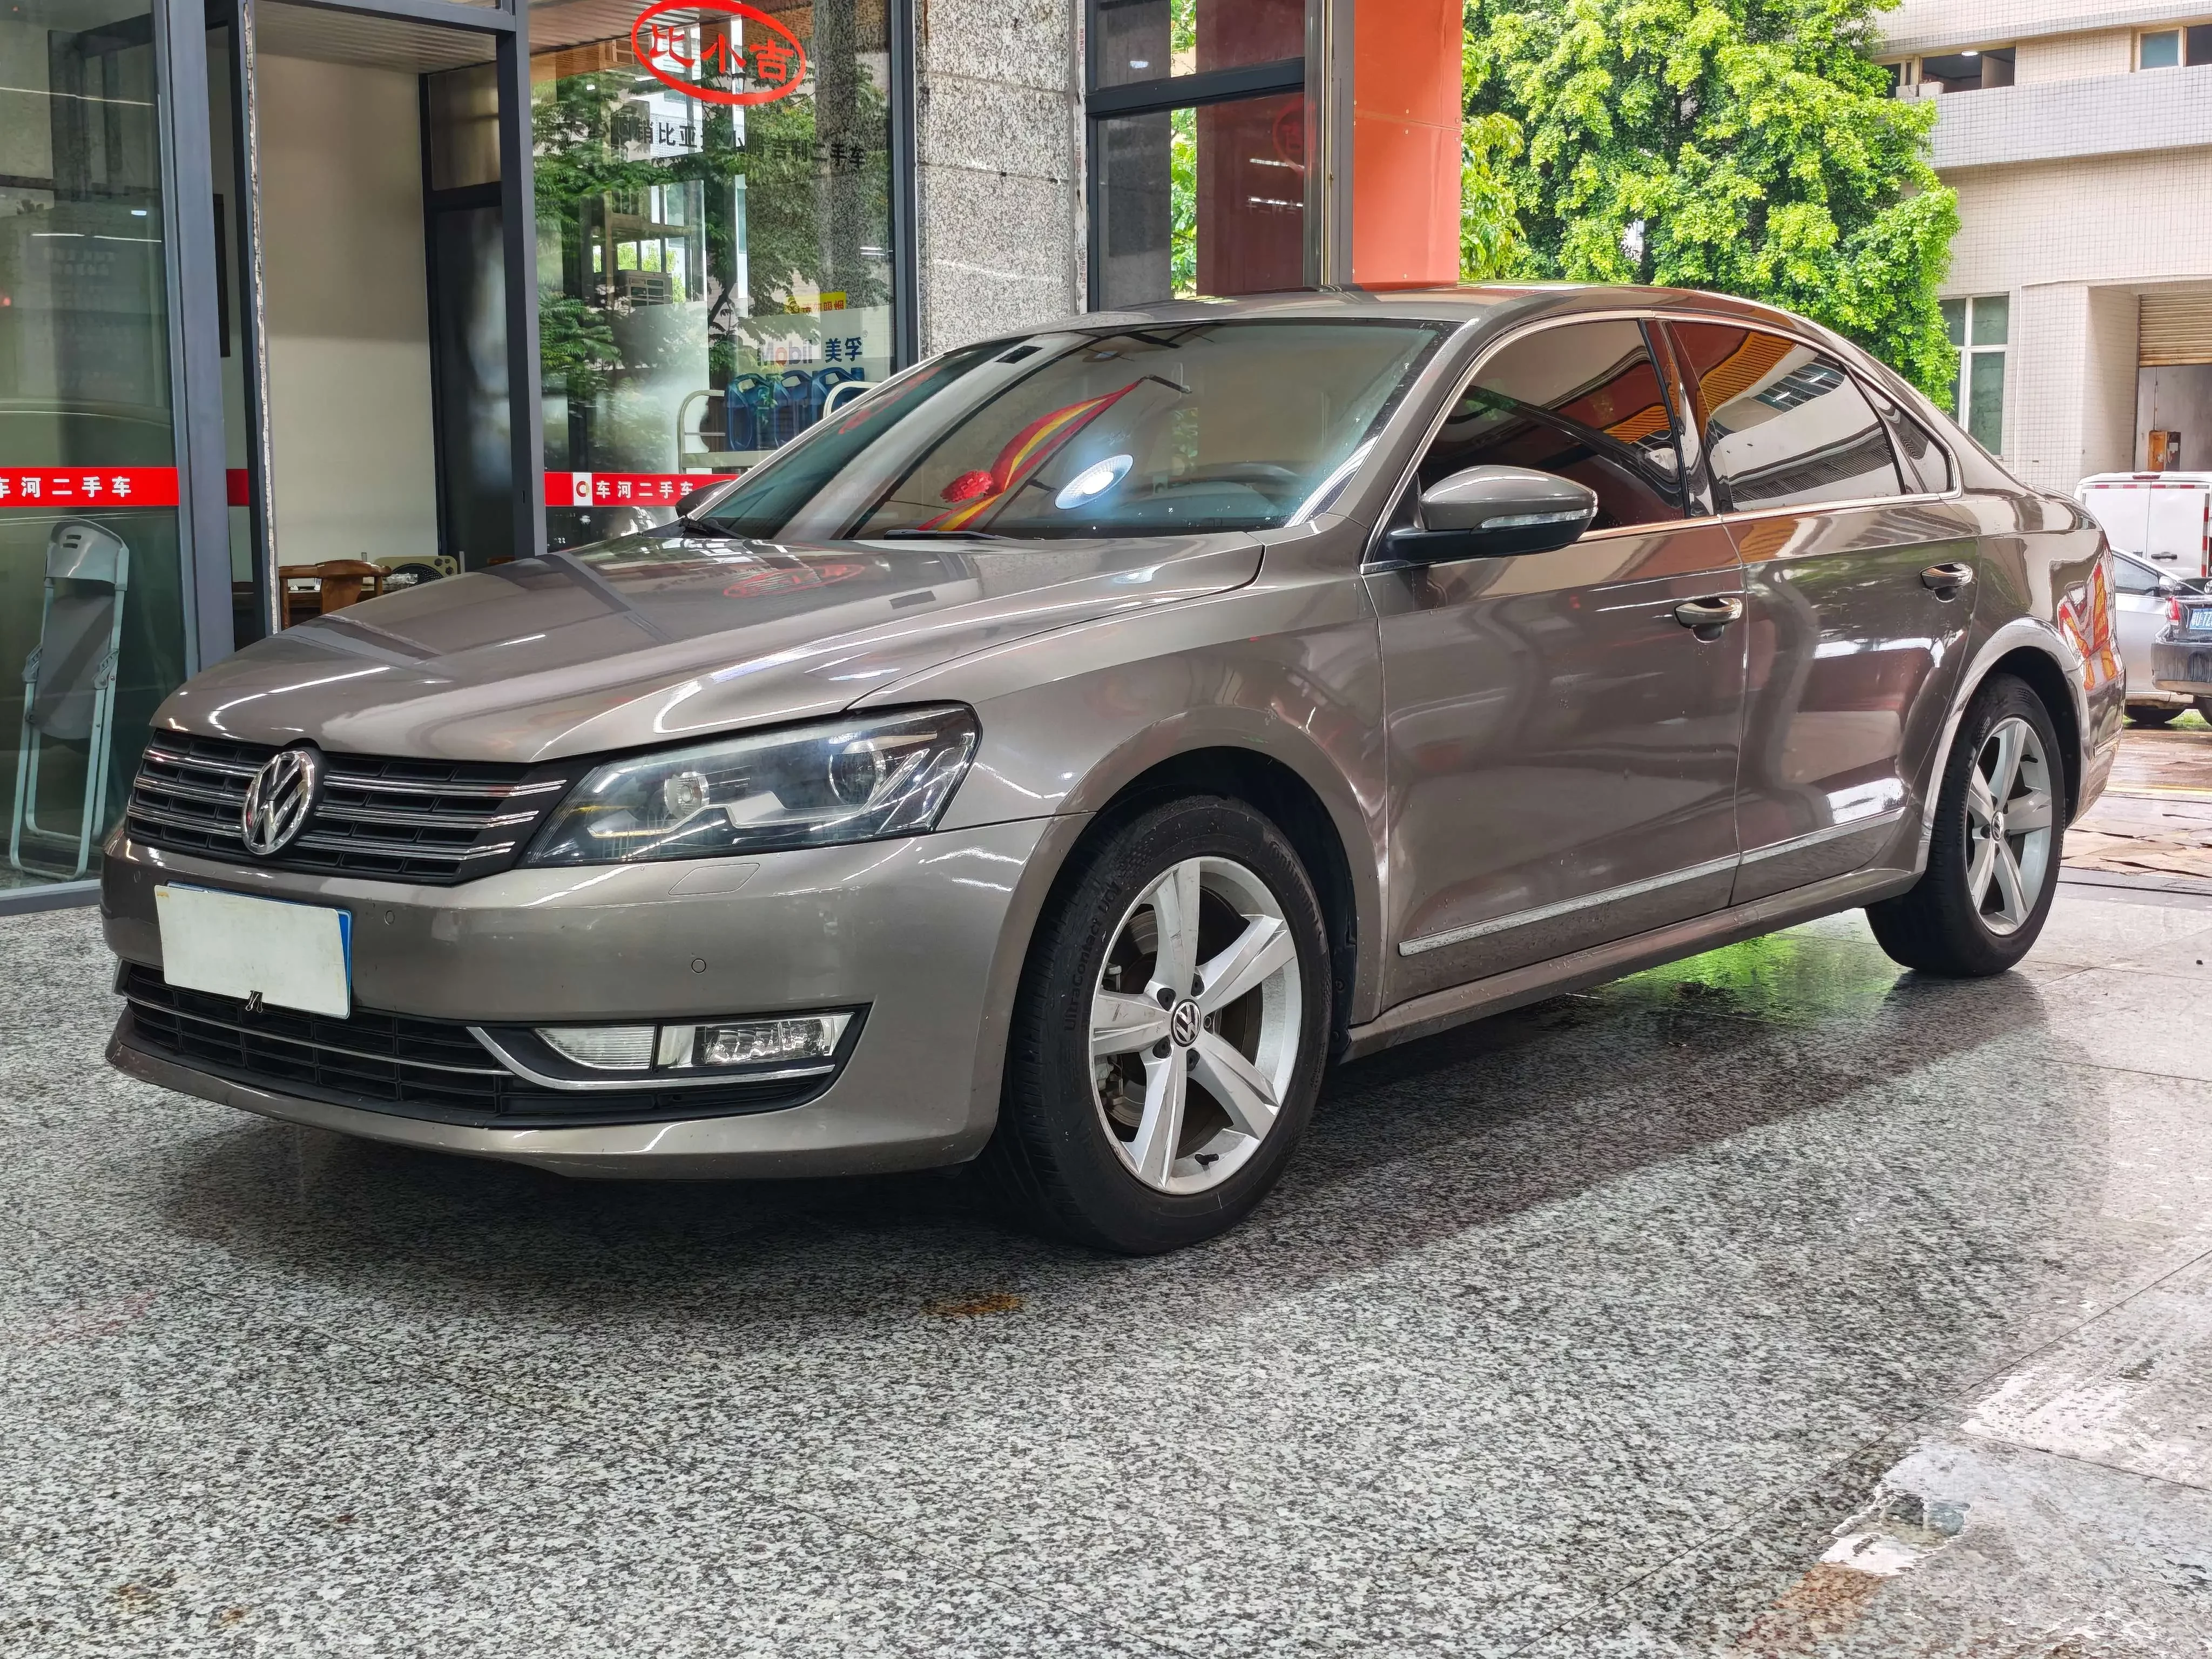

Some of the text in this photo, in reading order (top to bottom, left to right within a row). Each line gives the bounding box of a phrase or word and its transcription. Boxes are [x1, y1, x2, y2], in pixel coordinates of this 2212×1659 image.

[649, 24, 793, 80] 比小吉
[825, 337, 863, 363] 美孚
